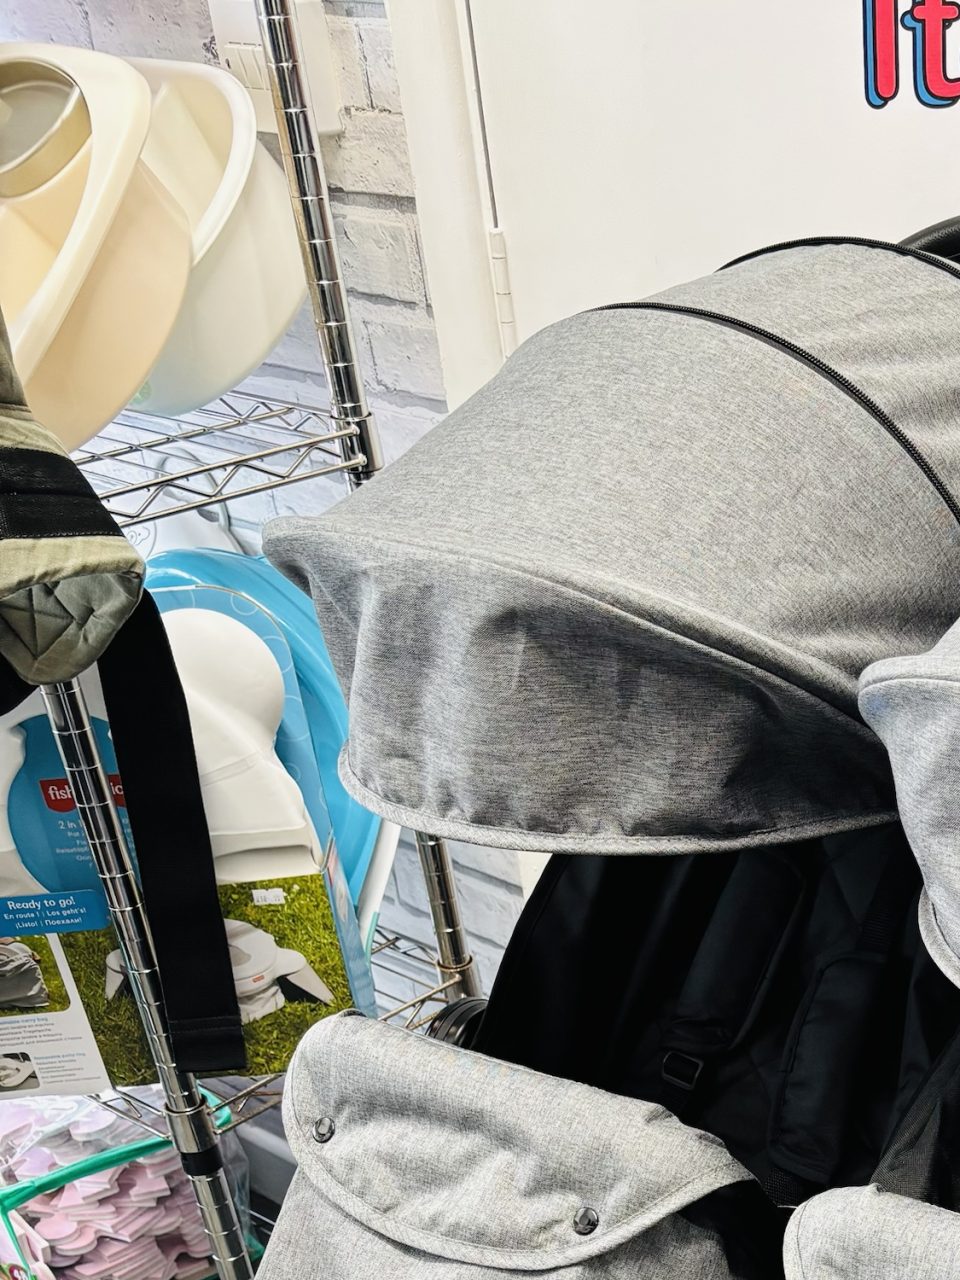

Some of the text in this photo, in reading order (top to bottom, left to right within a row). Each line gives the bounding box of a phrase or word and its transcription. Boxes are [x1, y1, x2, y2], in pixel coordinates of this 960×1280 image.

[7, 896, 76, 910] Ready to go!
[16, 911, 35, 920] route
[61, 907, 87, 917] geht's!
[15, 921, 38, 930] ¡Listo!
[45, 917, 82, 927] Поехали!
